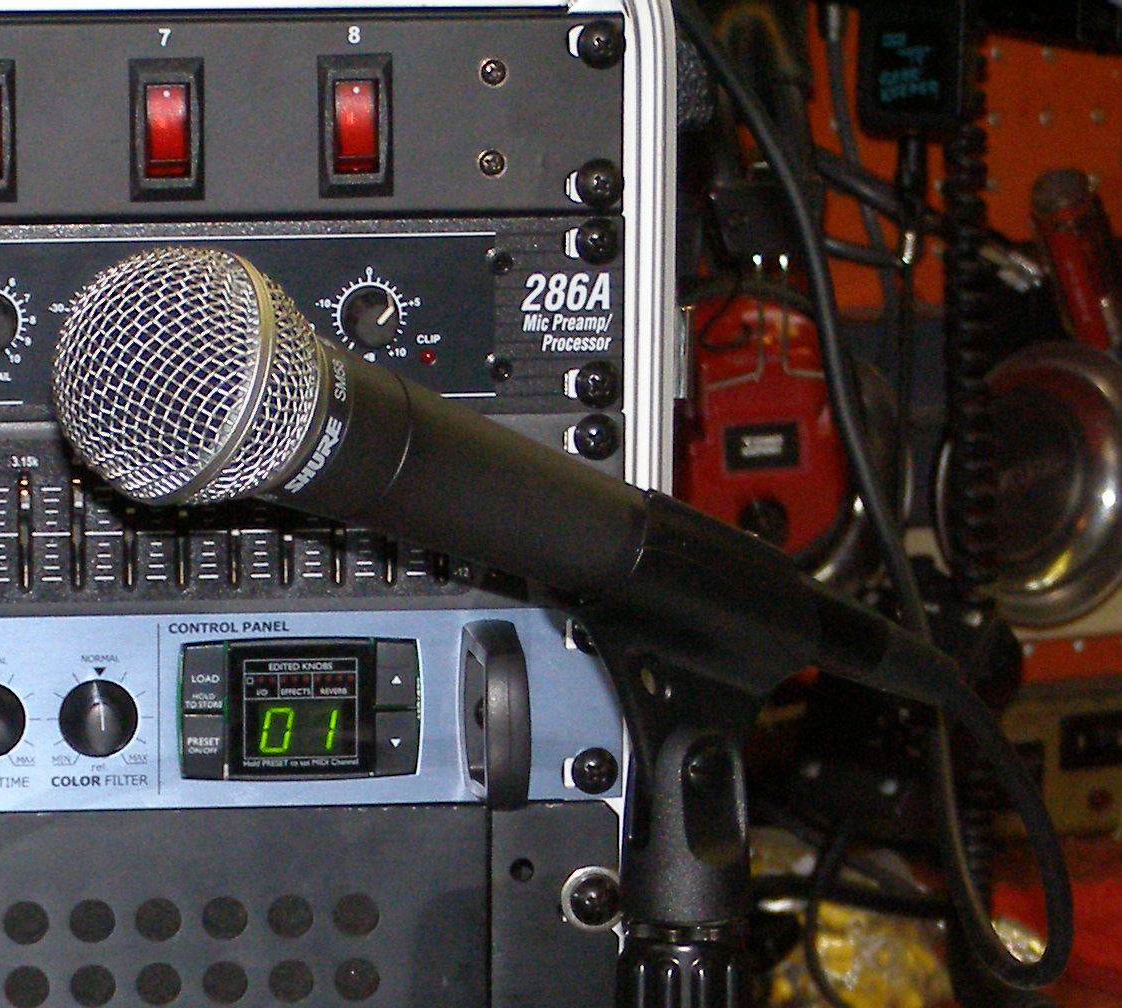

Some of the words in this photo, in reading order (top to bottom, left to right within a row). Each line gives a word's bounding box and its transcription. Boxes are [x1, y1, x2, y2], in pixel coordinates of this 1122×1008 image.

[159, 29, 172, 46] 7
[348, 26, 361, 45] 8
[521, 272, 611, 312] 286A
[522, 314, 549, 332] Mic
[552, 314, 612, 333] Preamp/
[416, 334, 441, 345] CLIP
[542, 333, 612, 352] Processor
[9, 354, 21, 364] 10
[284, 415, 343, 494] SHURE
[11, 455, 39, 469] 3.15k
[168, 622, 239, 634] CONTROL
[242, 621, 290, 633] PANEL
[81, 654, 120, 663] NORMAL
[268, 662, 300, 671] EDITED
[302, 662, 333, 671] KNOBS
[191, 674, 220, 683] LOAD
[280, 687, 311, 696] EFFECTS
[319, 687, 348, 695] REVERB
[192, 693, 216, 701] HOLD
[198, 700, 223, 709] STORE
[259, 707, 338, 754] 01
[187, 737, 220, 747] PRESET
[51, 776, 101, 787] COLOR
[105, 775, 149, 786] FILTER
